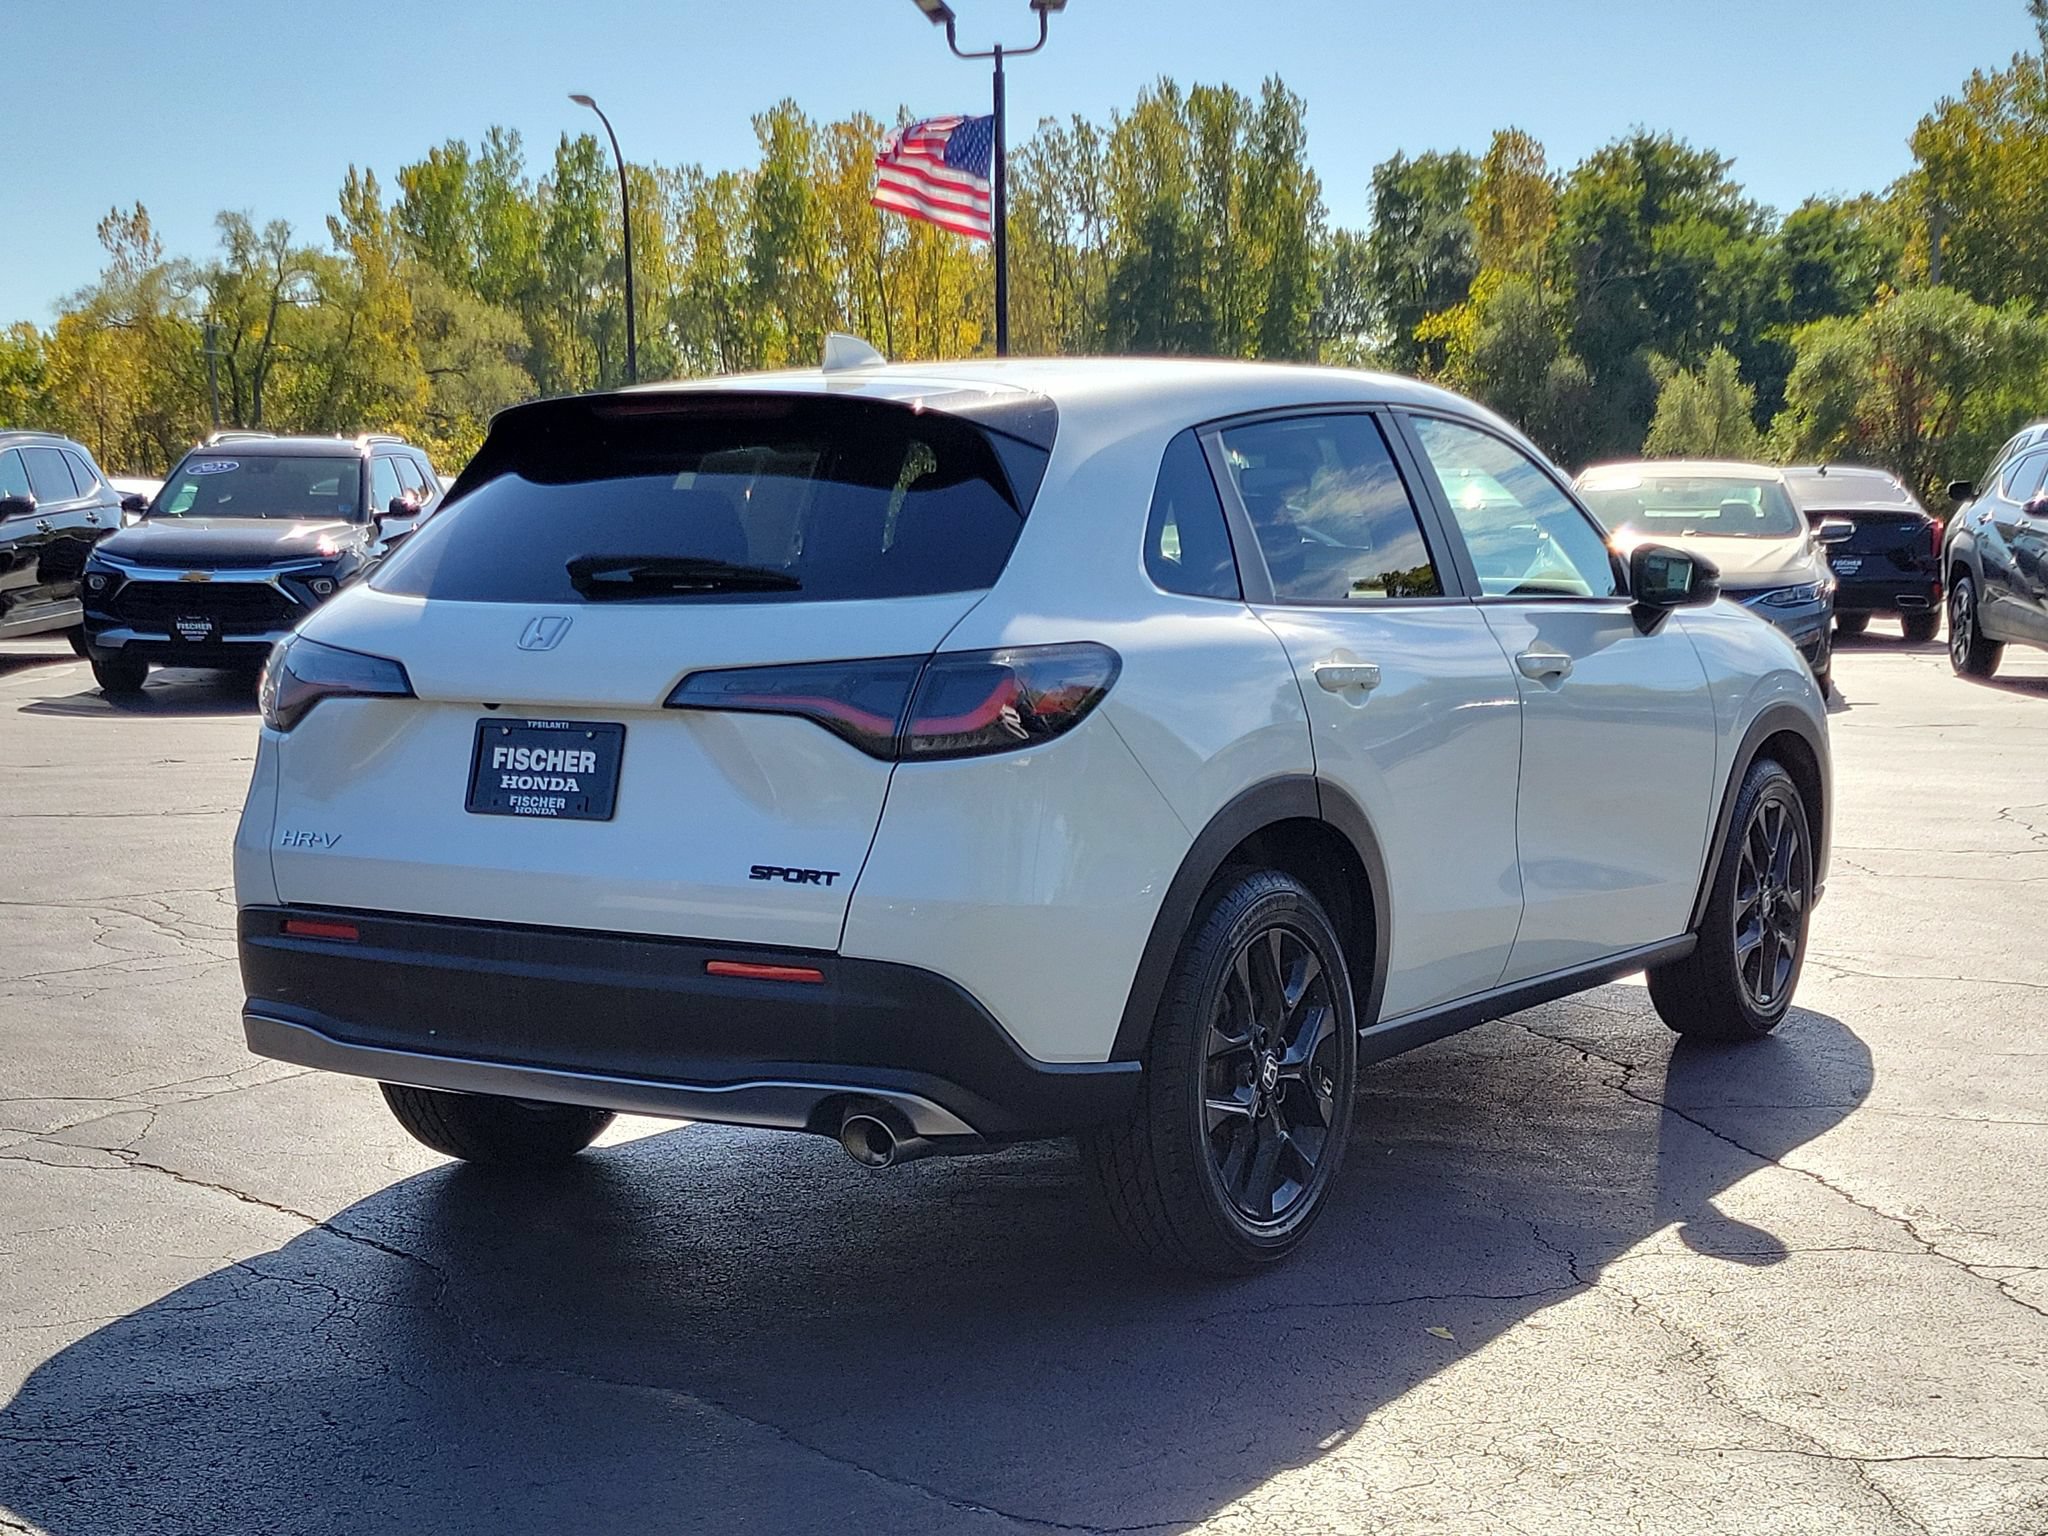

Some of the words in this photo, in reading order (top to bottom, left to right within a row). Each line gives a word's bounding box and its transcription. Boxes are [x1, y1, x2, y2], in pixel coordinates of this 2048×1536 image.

[527, 720, 569, 729] YPSILANTI
[492, 747, 596, 773] FISCHER
[500, 776, 580, 792] HONDA
[509, 795, 566, 809] FISCHER
[514, 806, 557, 816] HONDA
[281, 830, 342, 849] HR-V
[749, 865, 840, 887] SPORT
